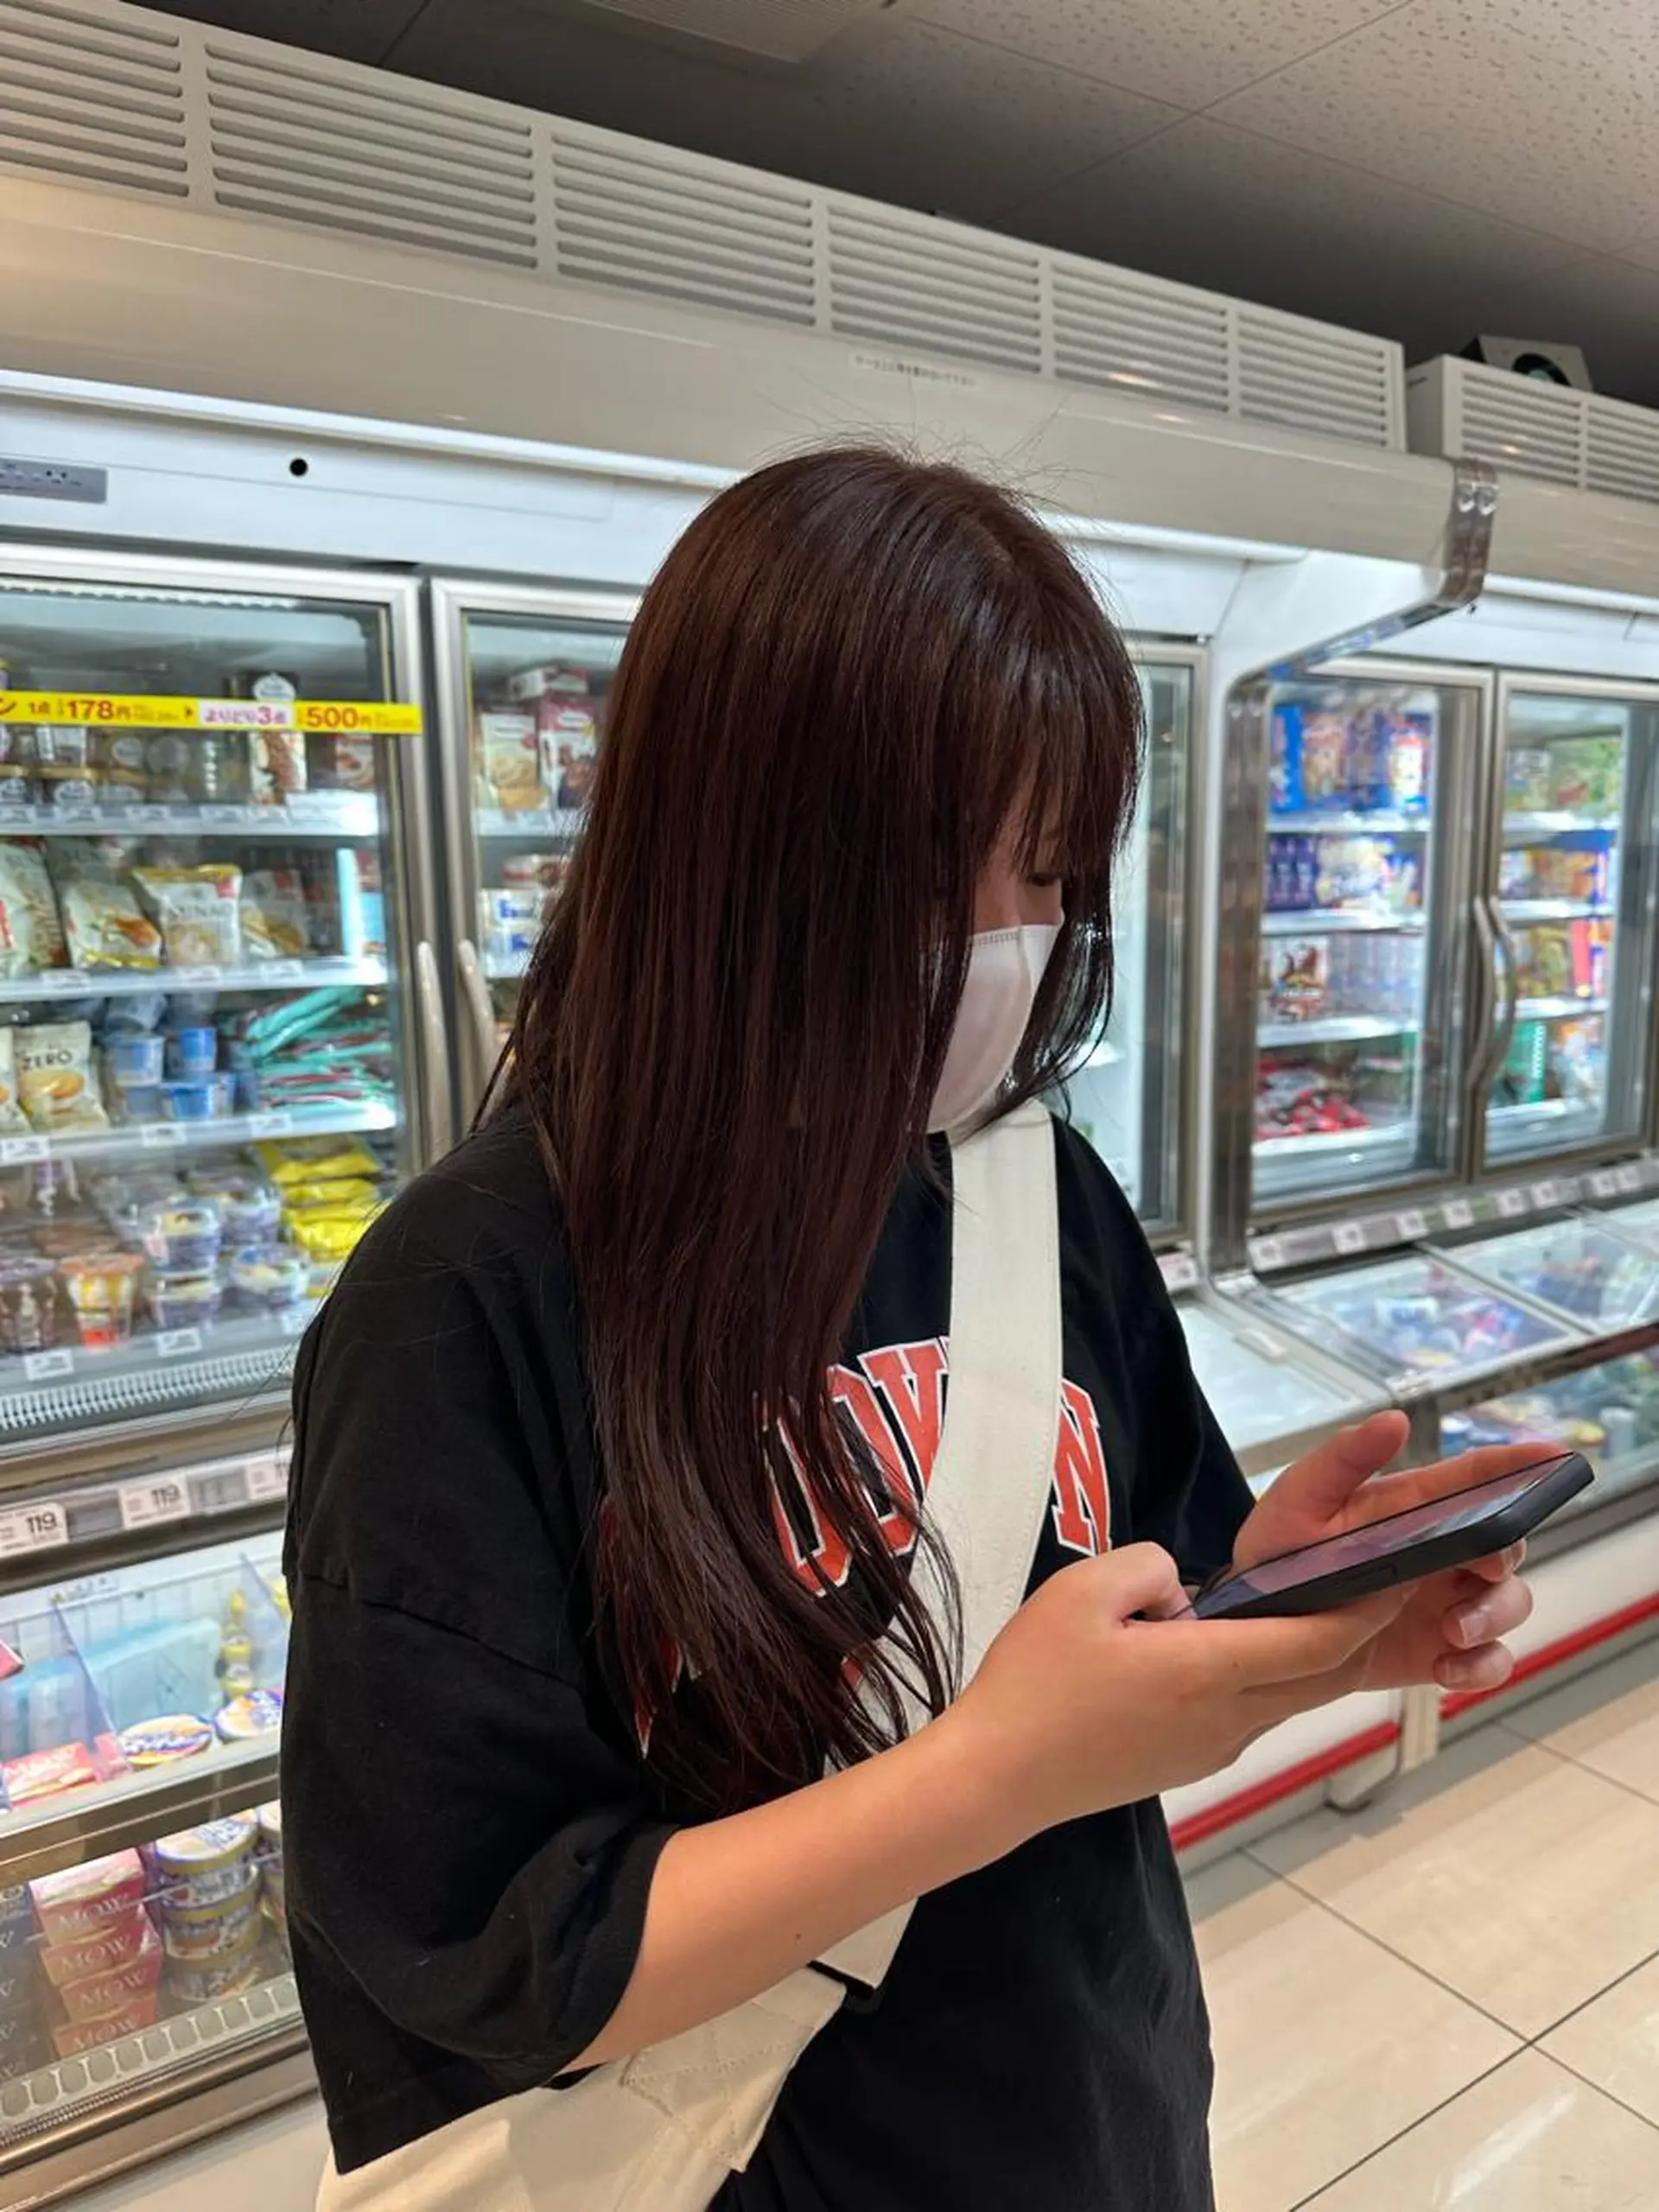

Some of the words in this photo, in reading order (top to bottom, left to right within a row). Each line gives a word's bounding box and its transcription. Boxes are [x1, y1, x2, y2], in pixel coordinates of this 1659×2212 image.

[22, 1048, 73, 1071] ZERO
[150, 1483, 180, 1507] 119
[25, 1510, 57, 1534] 119
[59, 1891, 130, 1930] MOW
[61, 1934, 131, 1974] MOW
[79, 1967, 148, 2006] MOW
[71, 2012, 141, 2051] MOW
